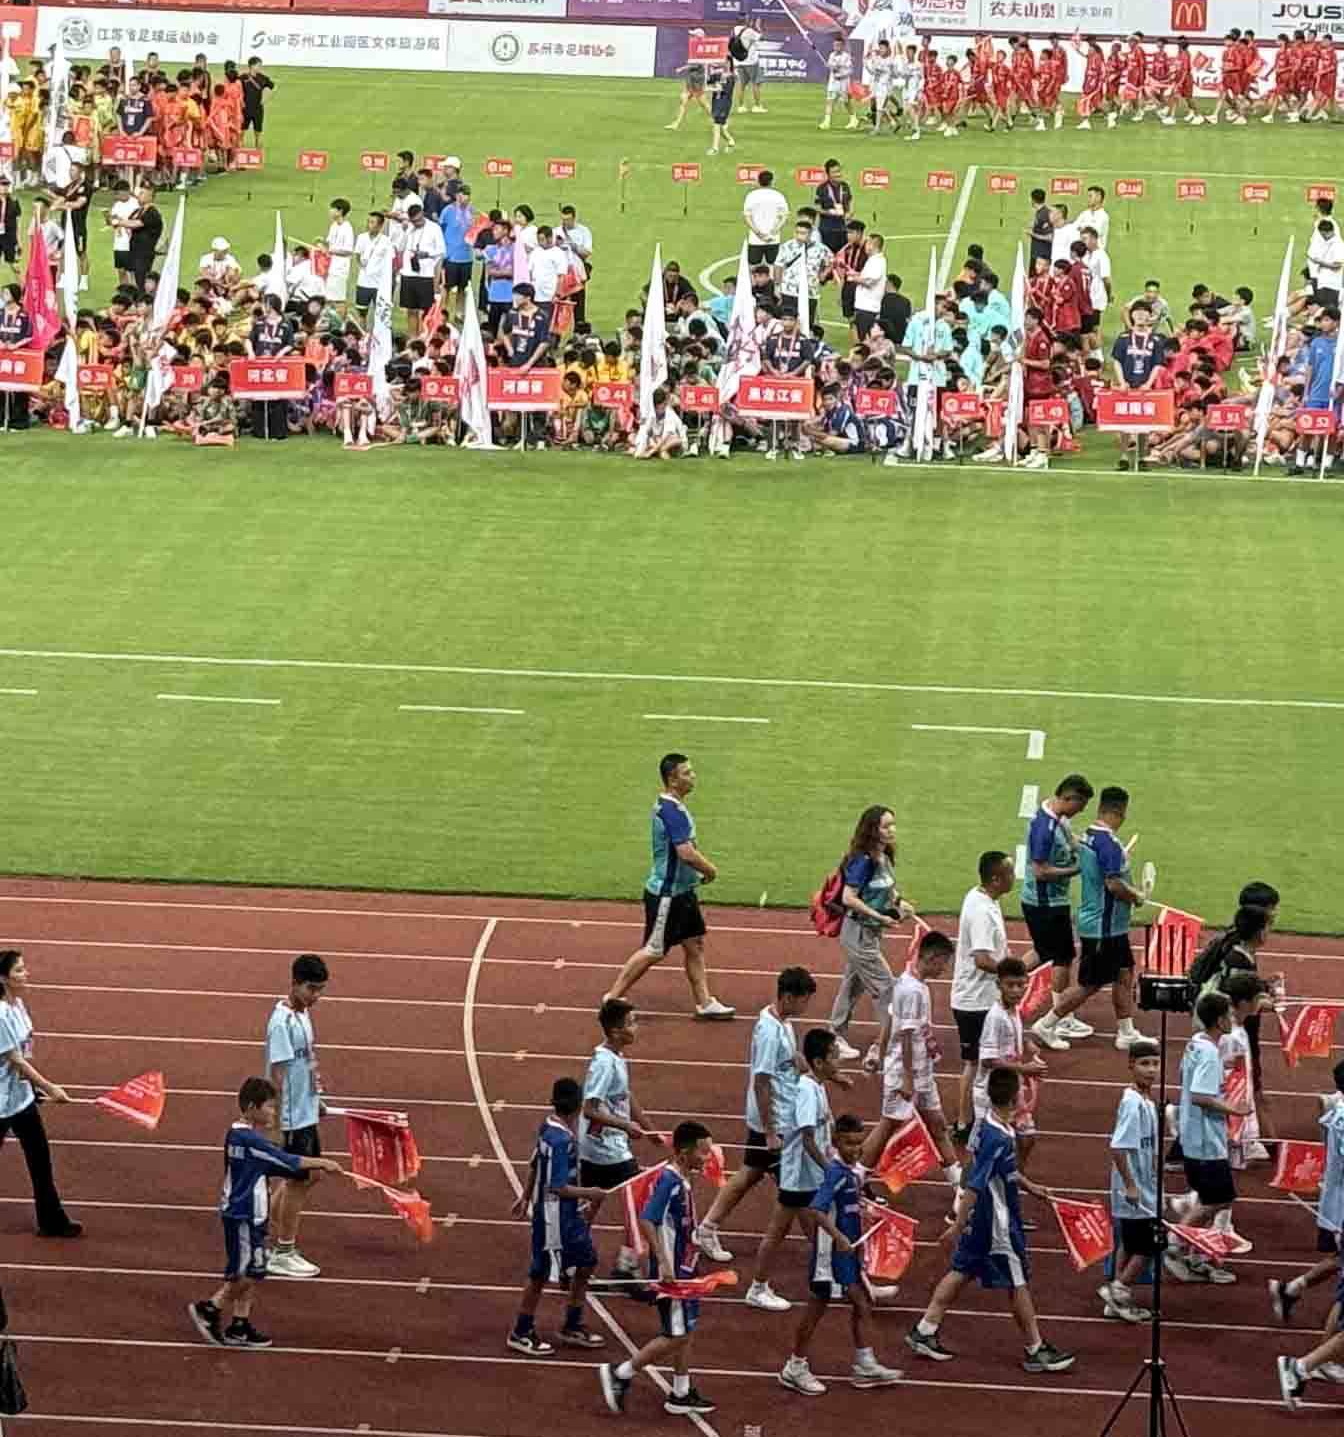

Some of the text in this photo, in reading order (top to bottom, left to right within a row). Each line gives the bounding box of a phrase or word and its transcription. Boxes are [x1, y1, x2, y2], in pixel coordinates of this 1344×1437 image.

[989, 0, 1056, 19] 农夫山泉
[97, 26, 220, 46] 江苏省足球运动协会
[247, 368, 288, 383] 河北省
[748, 386, 804, 403] 黑龙江省
